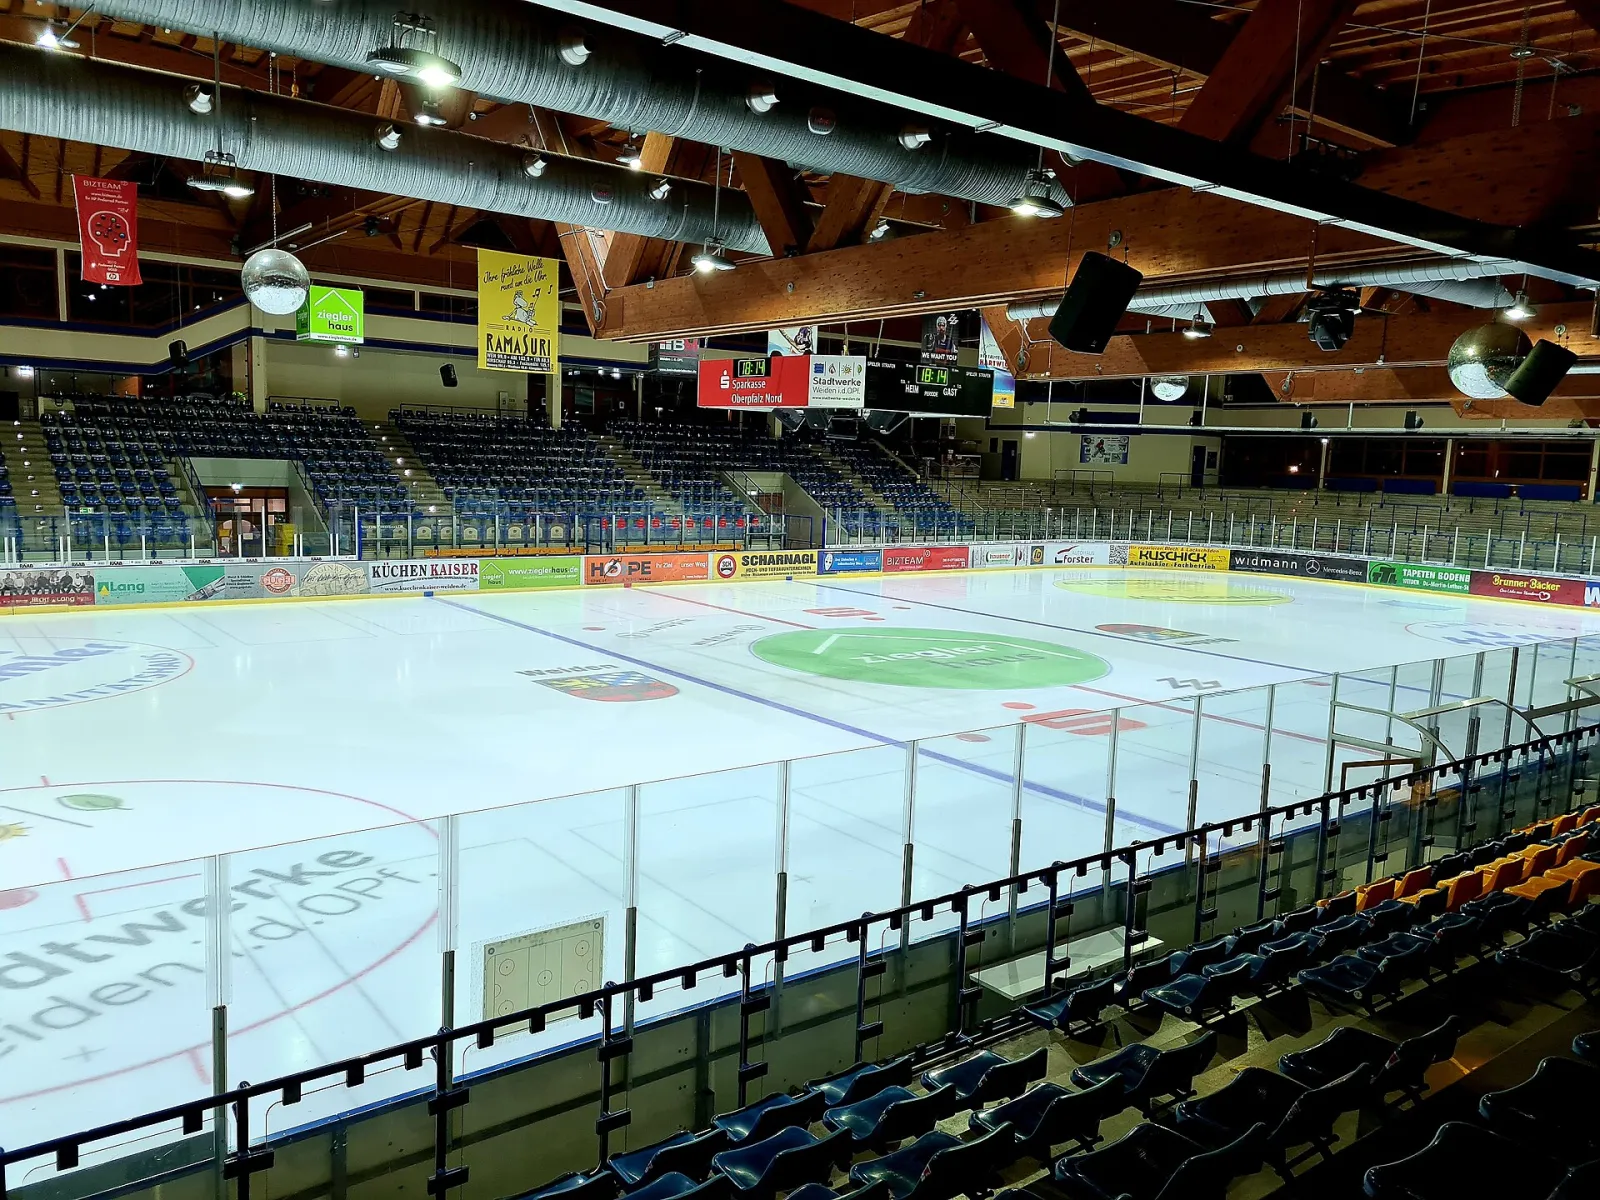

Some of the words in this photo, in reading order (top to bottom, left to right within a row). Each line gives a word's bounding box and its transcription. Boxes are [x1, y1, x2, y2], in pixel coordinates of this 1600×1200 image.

[83, 180, 122, 190] BIZTEAM
[317, 310, 352, 322] ziegler
[329, 320, 353, 331] haus
[742, 361, 764, 375] 18:14
[921, 368, 947, 383] 18:14
[732, 379, 766, 390] Sparkasse
[813, 377, 861, 386] Stadtwerke
[905, 384, 919, 393] HEIM
[943, 388, 958, 397] GAST
[731, 393, 764, 405] Oberpfalz
[765, 393, 782, 403] Nord
[742, 554, 816, 566] SCHARNAGL
[887, 557, 923, 565] BIZTEAM
[1063, 555, 1094, 563] forster
[1139, 550, 1207, 562] KUSCHICK
[1235, 556, 1297, 569] widmann
[372, 562, 427, 578] KÜCHEN
[430, 563, 478, 576] KAISER
[508, 566, 578, 575] www.zieglerhaus.de
[1323, 566, 1362, 576] Mercedes-Benz
[1403, 569, 1435, 579] TAPETEN
[1492, 575, 1529, 588] Brunner
[110, 582, 144, 593] Lang
[515, 662, 618, 678] Weiden
